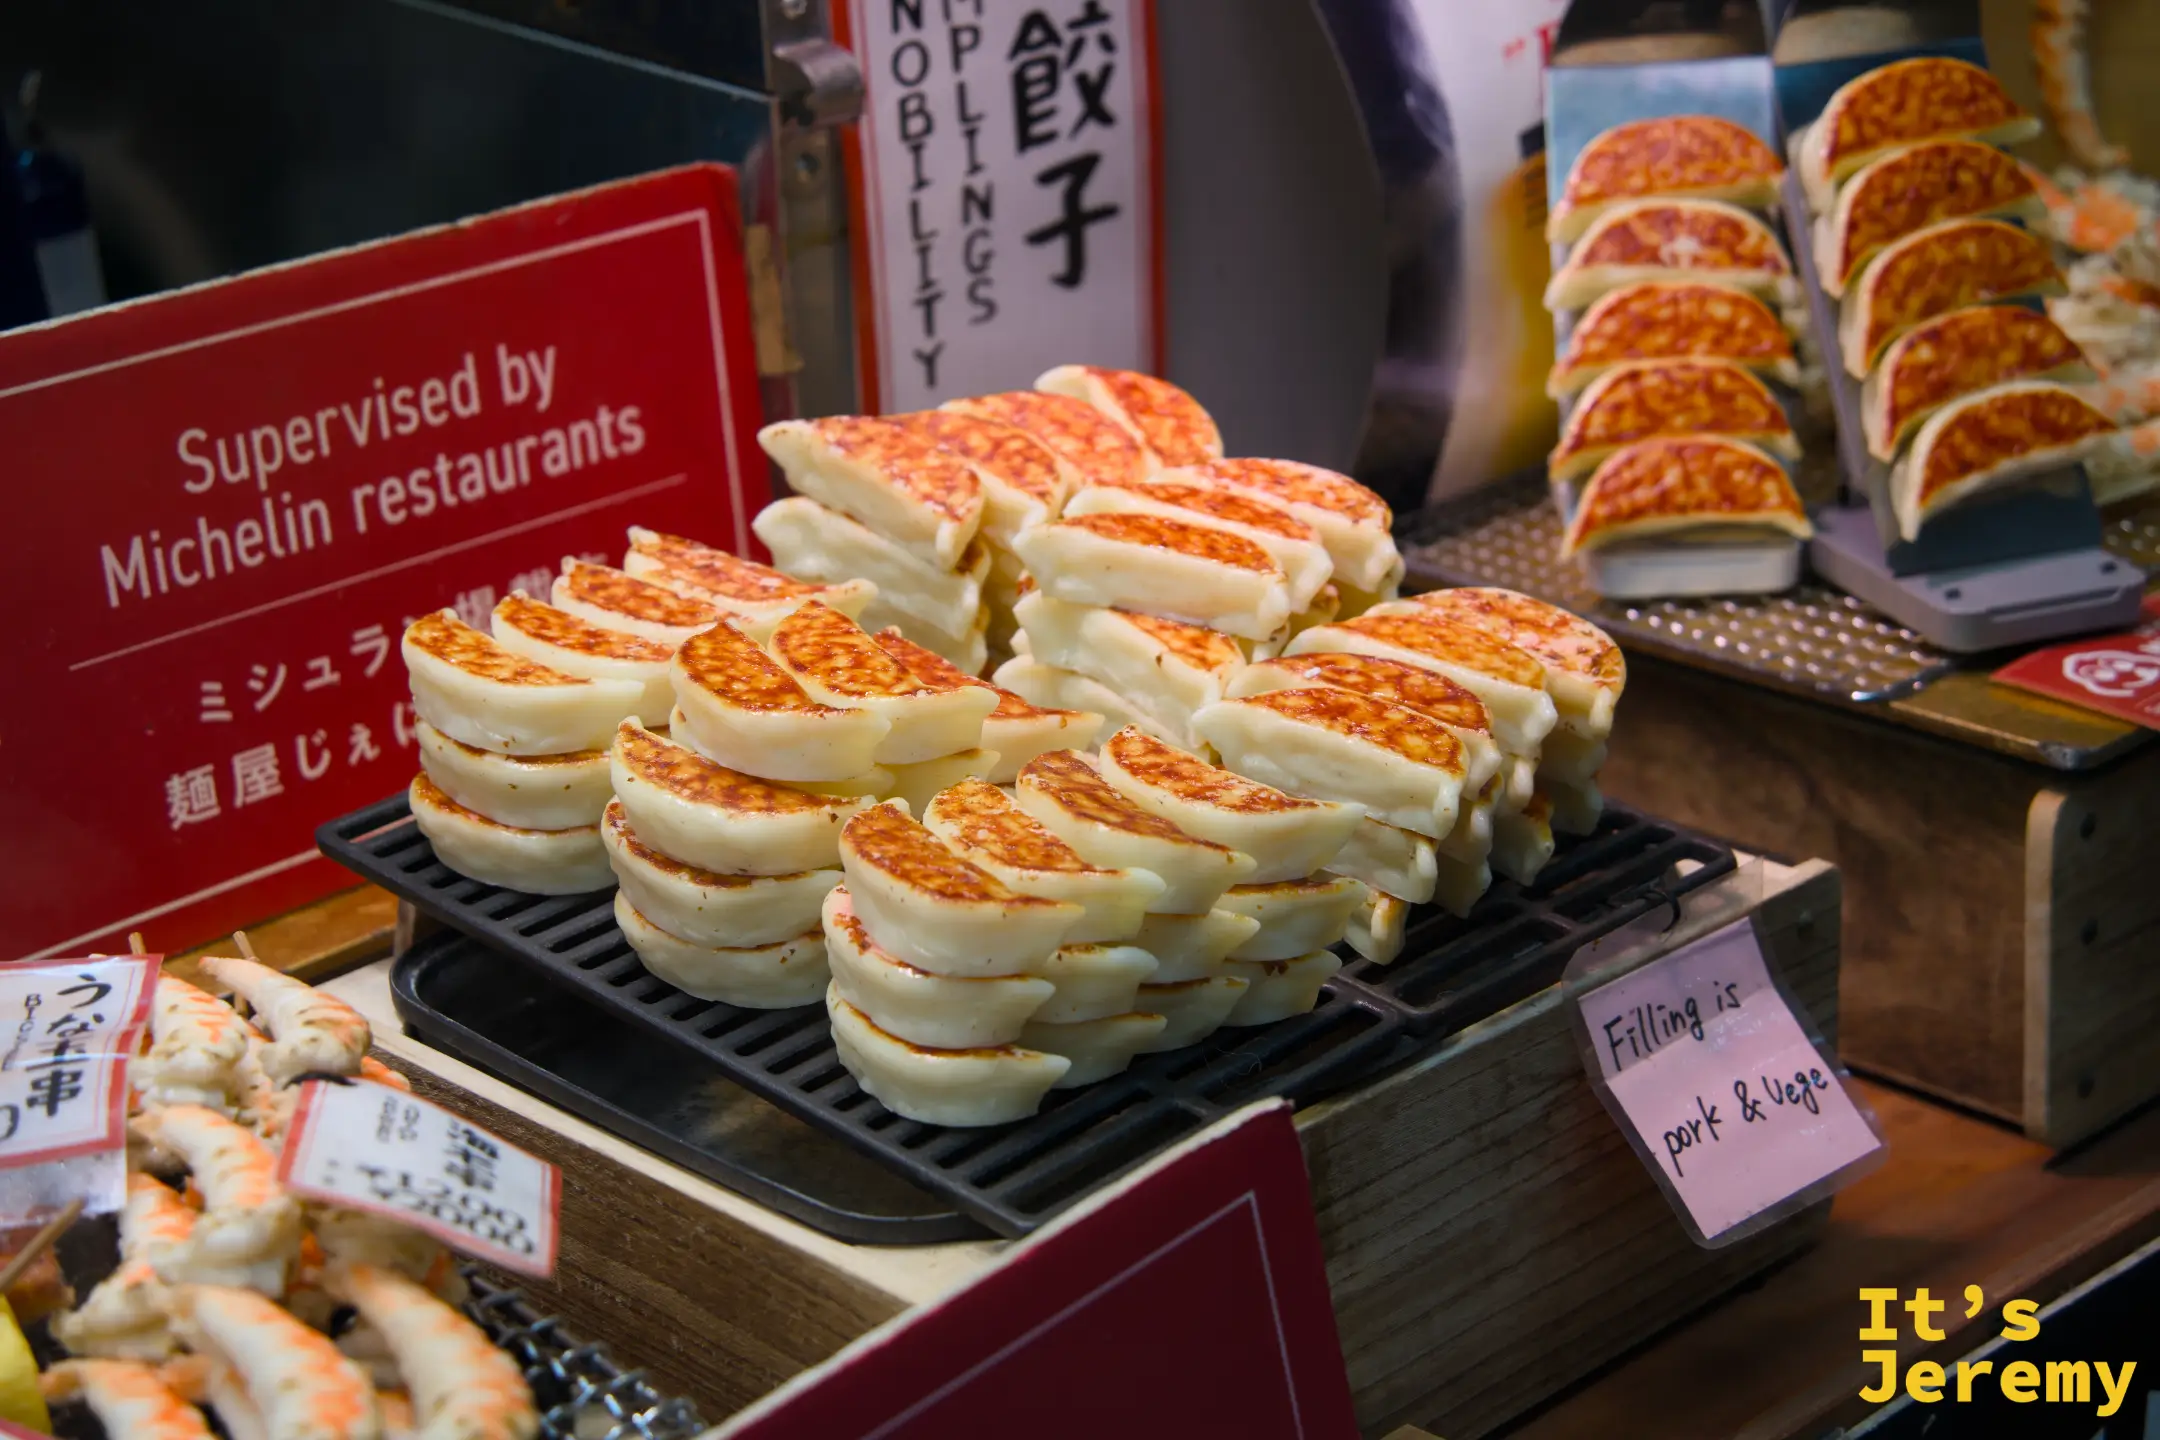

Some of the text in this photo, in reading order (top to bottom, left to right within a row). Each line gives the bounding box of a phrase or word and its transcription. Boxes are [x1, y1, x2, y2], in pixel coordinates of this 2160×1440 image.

[890, 0, 945, 388] NOBILITY
[1007, 0, 1119, 288] 餃子
[177, 343, 557, 493] Supervised by
[101, 405, 646, 608] Michelin restaurants
[1603, 981, 1741, 1071] Filling is
[1663, 1096, 1722, 1178] pork
[1733, 1080, 1767, 1122] &
